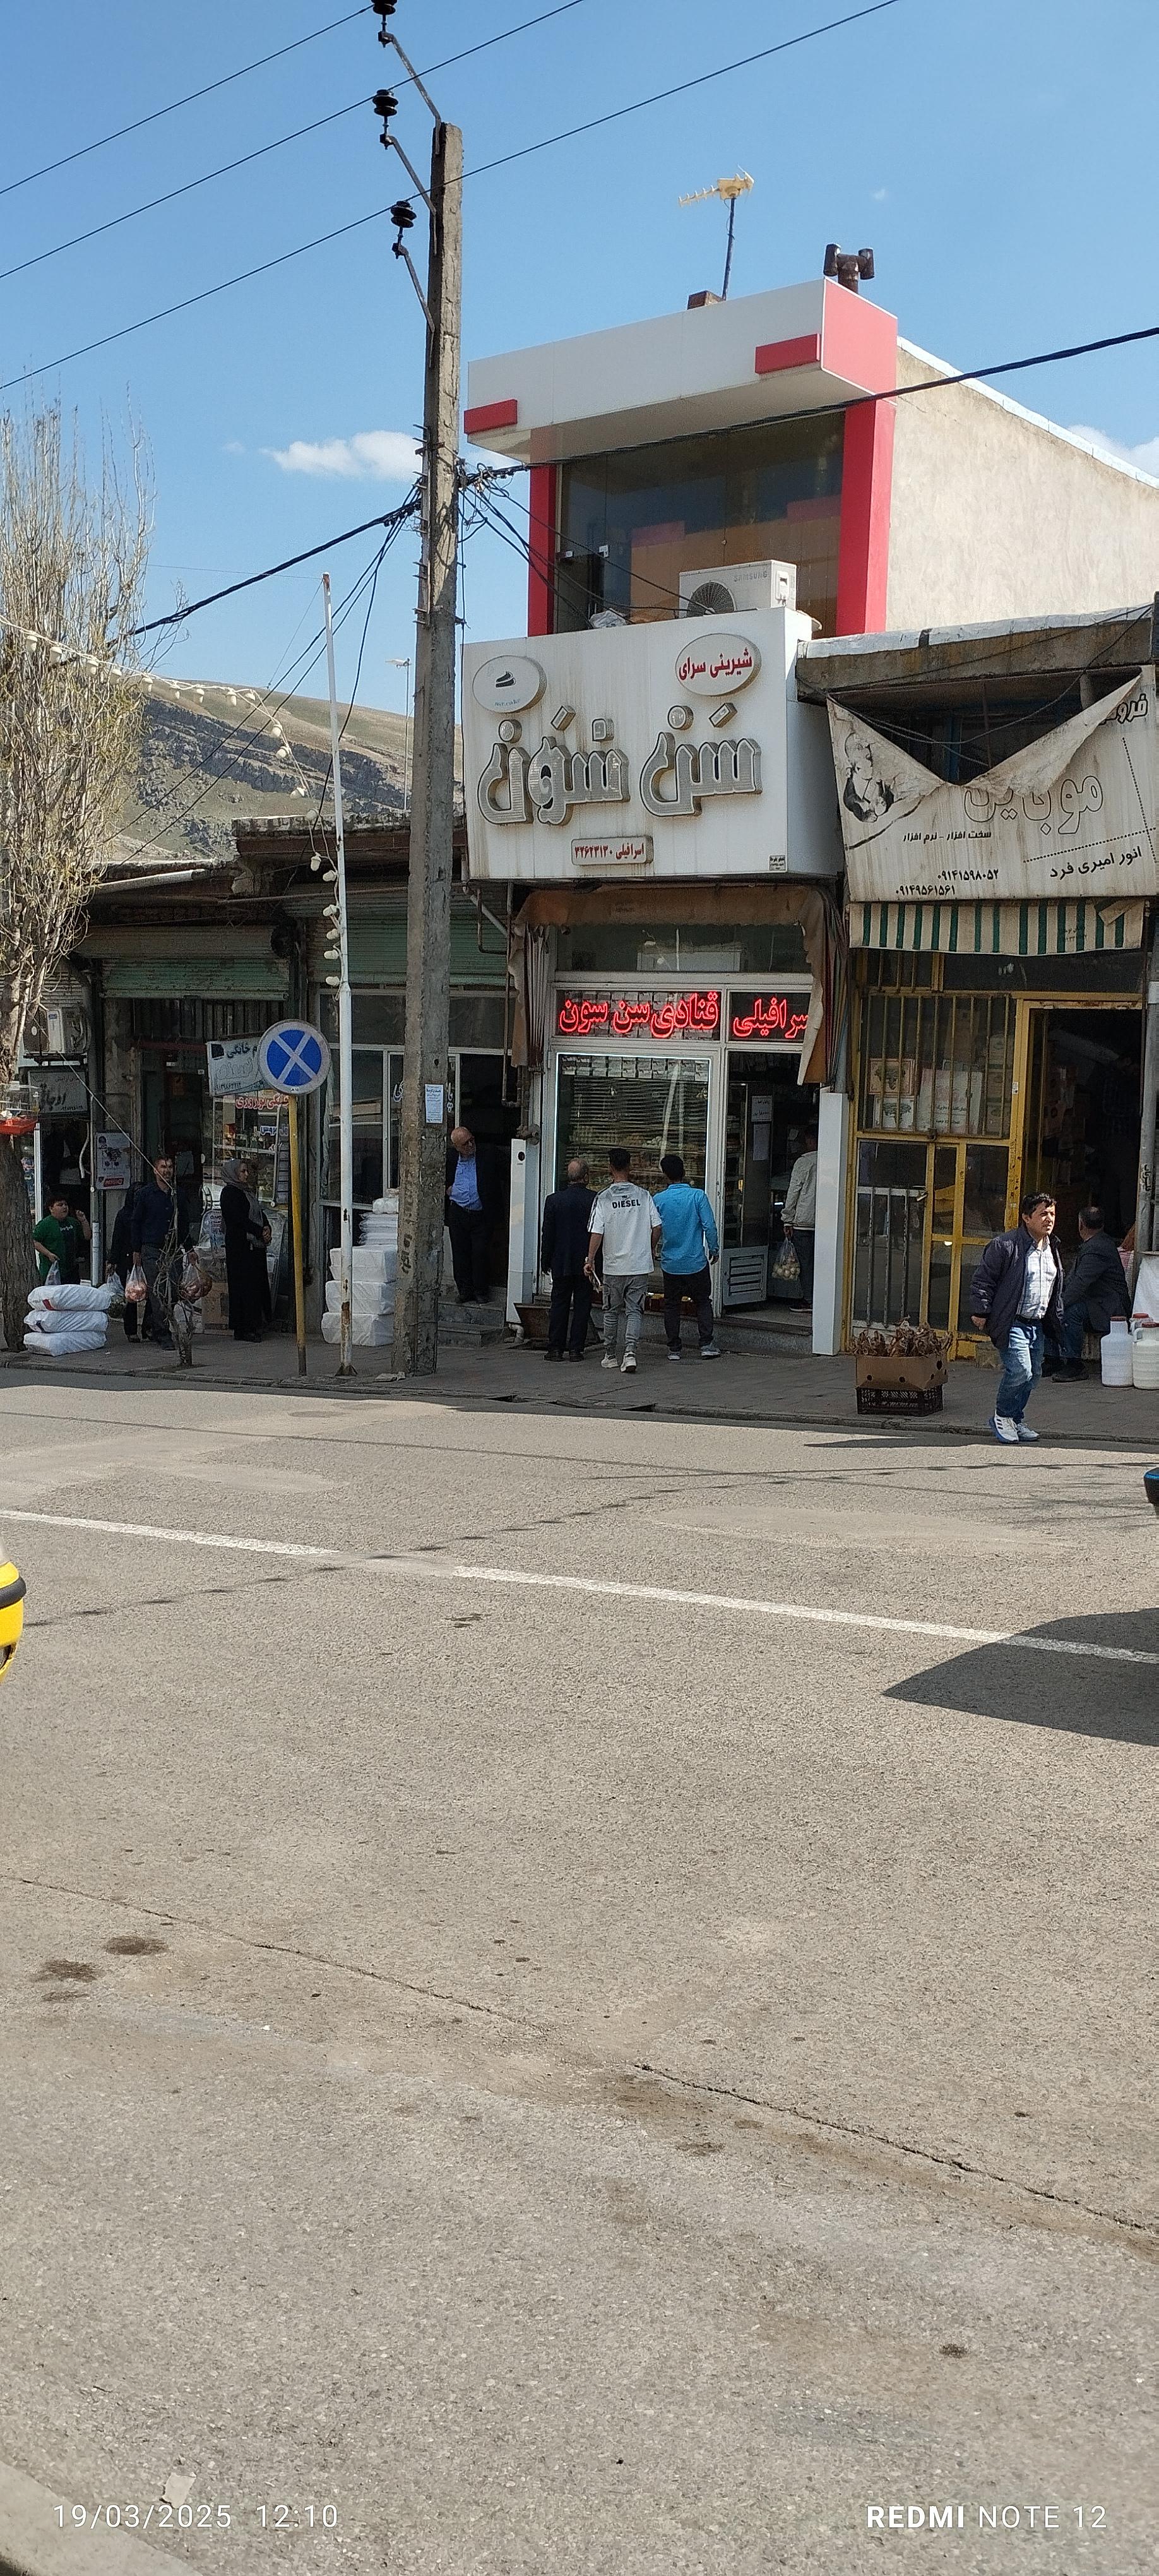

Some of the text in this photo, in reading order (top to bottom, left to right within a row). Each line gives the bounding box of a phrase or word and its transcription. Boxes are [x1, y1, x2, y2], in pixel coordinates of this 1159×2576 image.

[679, 647, 752, 681] شیرینی سرای
[903, 832, 922, 842] افزار
[923, 832, 937, 844] نرم
[946, 831, 966, 841] افزار
[968, 830, 992, 839] سخت
[615, 842, 645, 860] اسرافیلی
[1050, 845, 1142, 880] انور امیری فرد
[937, 869, 999, 881] ۰۹۱۴۱۵۹۸۰۵۲
[896, 885, 955, 896] ۰۹۱۴۹۵۶۱۵۶۱
[559, 991, 718, 1039] قنادی سن سون
[733, 997, 809, 1039] سرافیلی
[612, 1199, 641, 1209] DIESEL
